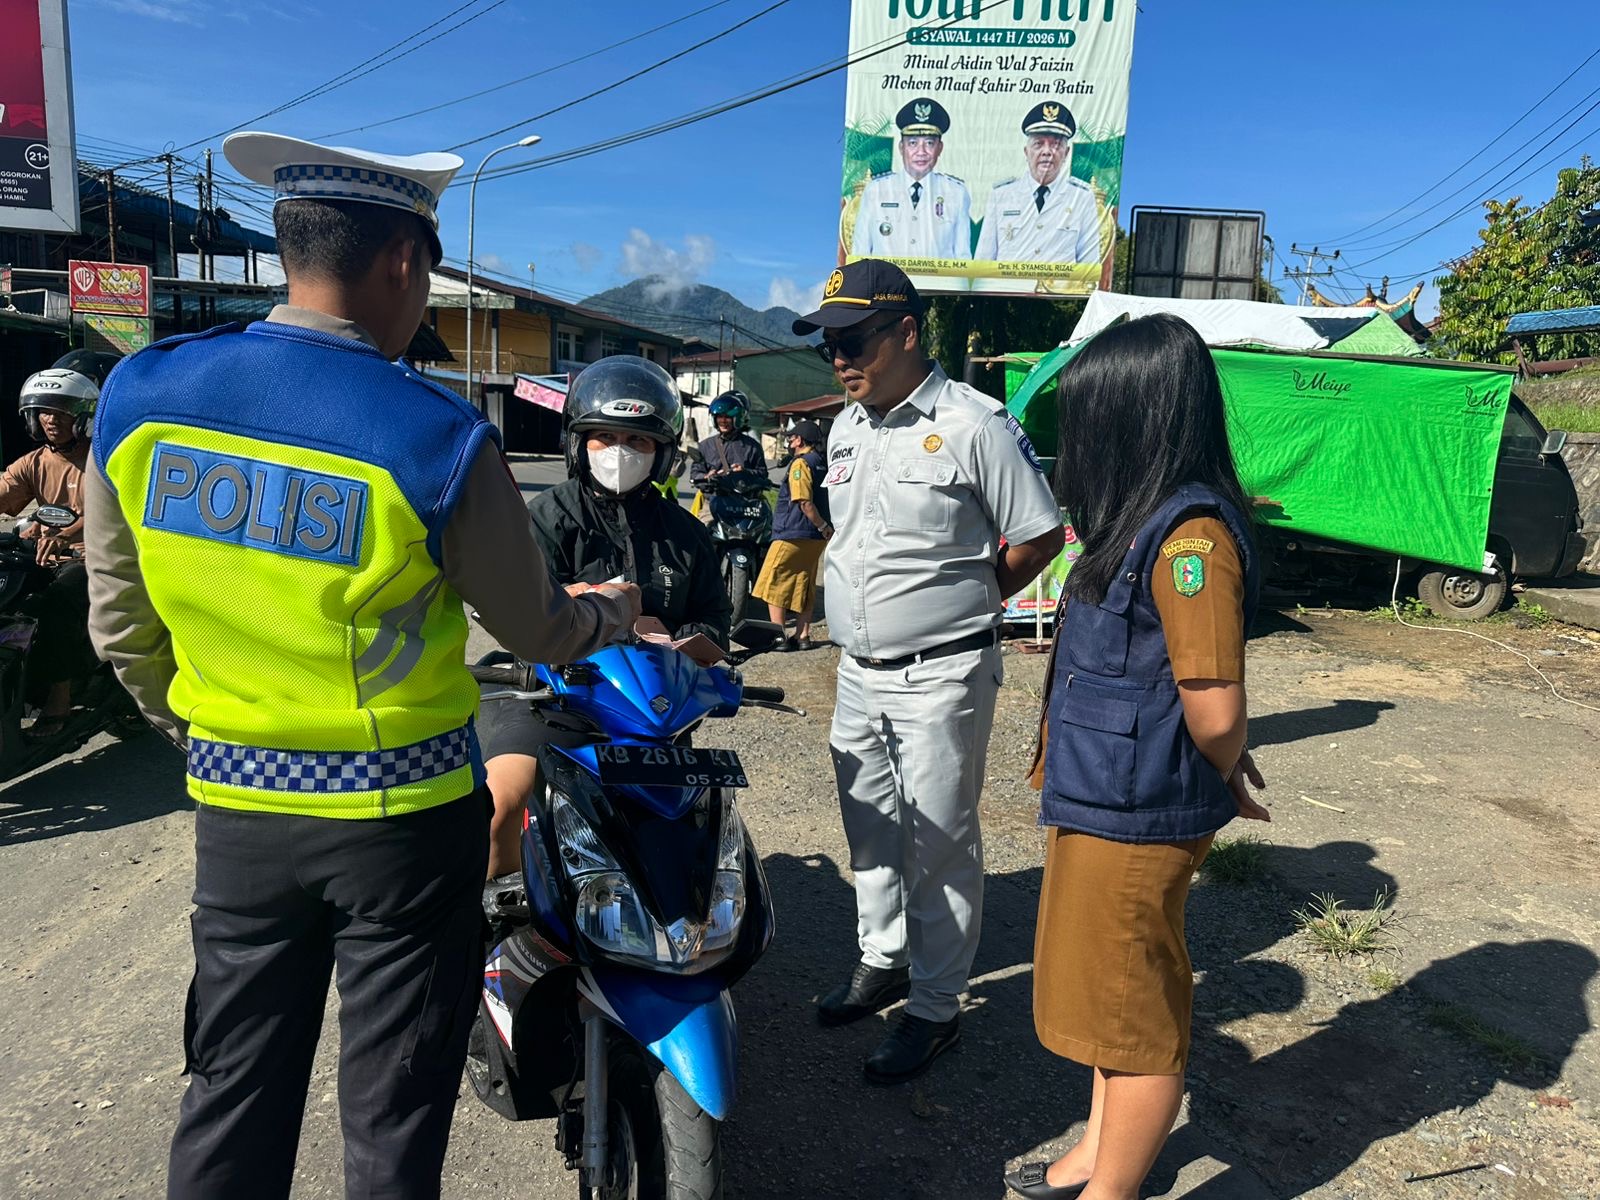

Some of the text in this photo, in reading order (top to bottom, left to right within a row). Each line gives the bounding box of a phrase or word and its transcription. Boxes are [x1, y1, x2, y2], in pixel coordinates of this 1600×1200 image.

[921, 30, 972, 43] SYAWAL
[976, 32, 1003, 43] 1447
[1006, 31, 1016, 43] H
[1027, 32, 1055, 44] 2026
[1058, 32, 1070, 44] M
[903, 54, 1074, 71] Minal Aidin Wal Faizin
[881, 75, 1094, 94] Mohon Maaf Lahir Dan Batin
[29, 151, 49, 162] 21+
[2, 186, 28, 194] ORANG
[1054, 264, 1074, 272] RIZAL
[1293, 370, 1352, 397] Meiye
[613, 402, 645, 414] GM
[150, 450, 364, 558] POLISI
[598, 746, 630, 764] KB
[640, 747, 697, 766] 2616
